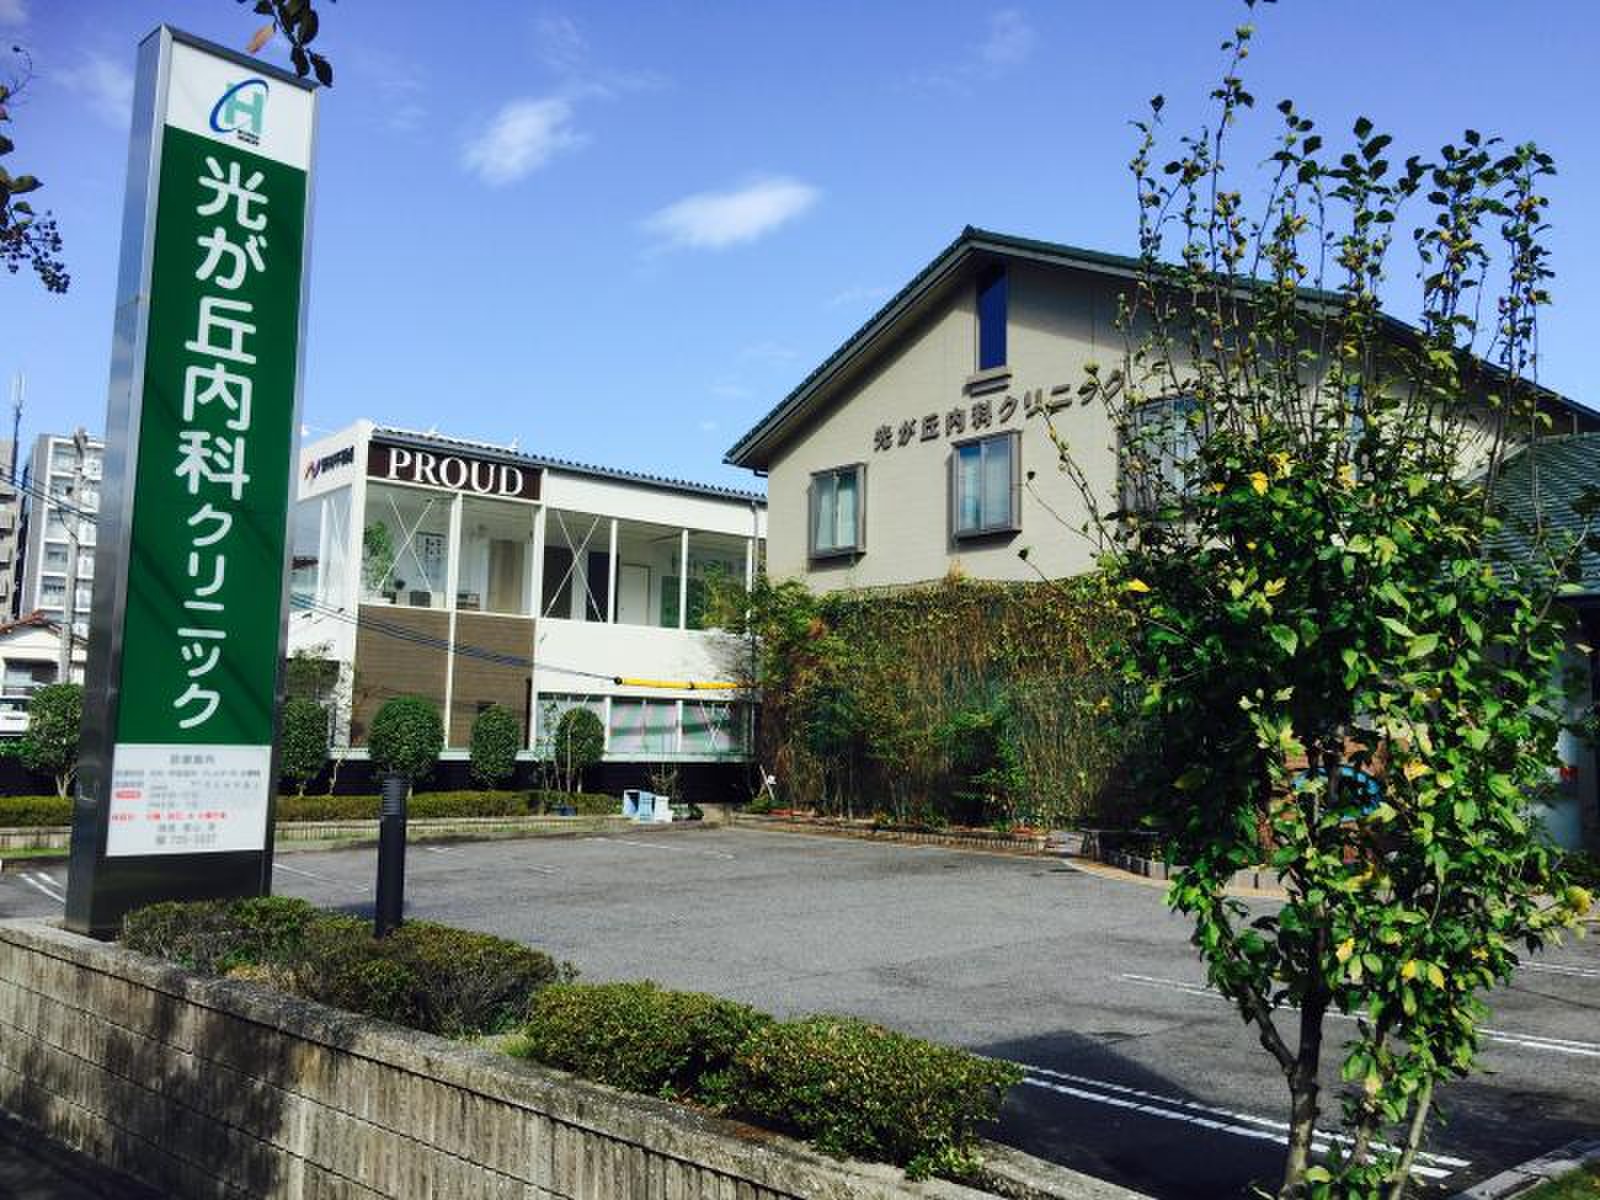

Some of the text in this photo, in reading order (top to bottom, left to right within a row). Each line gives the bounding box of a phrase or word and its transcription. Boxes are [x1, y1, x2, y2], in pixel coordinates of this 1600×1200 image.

[173, 155, 269, 729] 光が丘内科クリニック
[387, 447, 524, 496] PROUD
